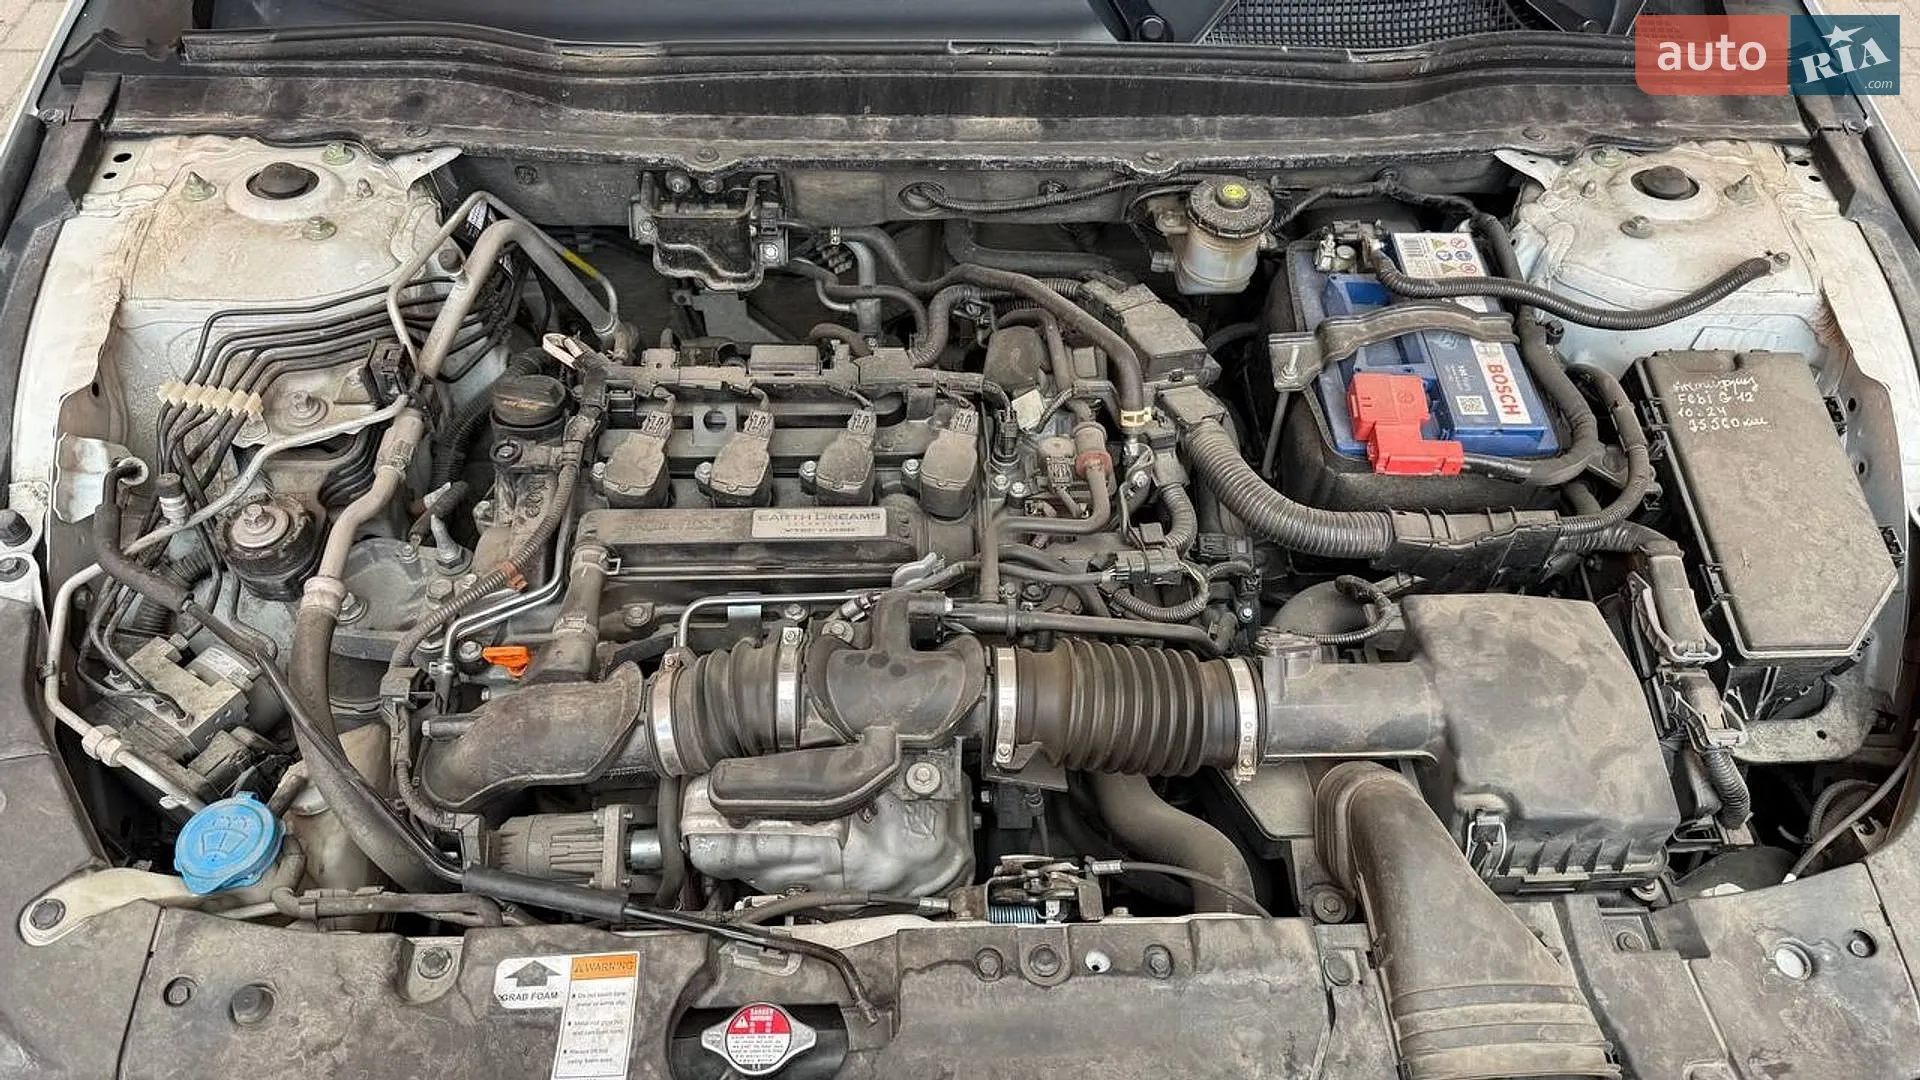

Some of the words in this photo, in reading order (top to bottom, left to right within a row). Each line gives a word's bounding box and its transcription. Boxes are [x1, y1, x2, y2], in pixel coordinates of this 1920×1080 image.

[1487, 364, 1521, 415] BOSCH
[758, 513, 812, 521] EARTH
[816, 512, 881, 520] DREAMS
[583, 961, 637, 972] WARNING
[502, 993, 529, 1001] GRAB
[531, 991, 559, 1000] FOAM
